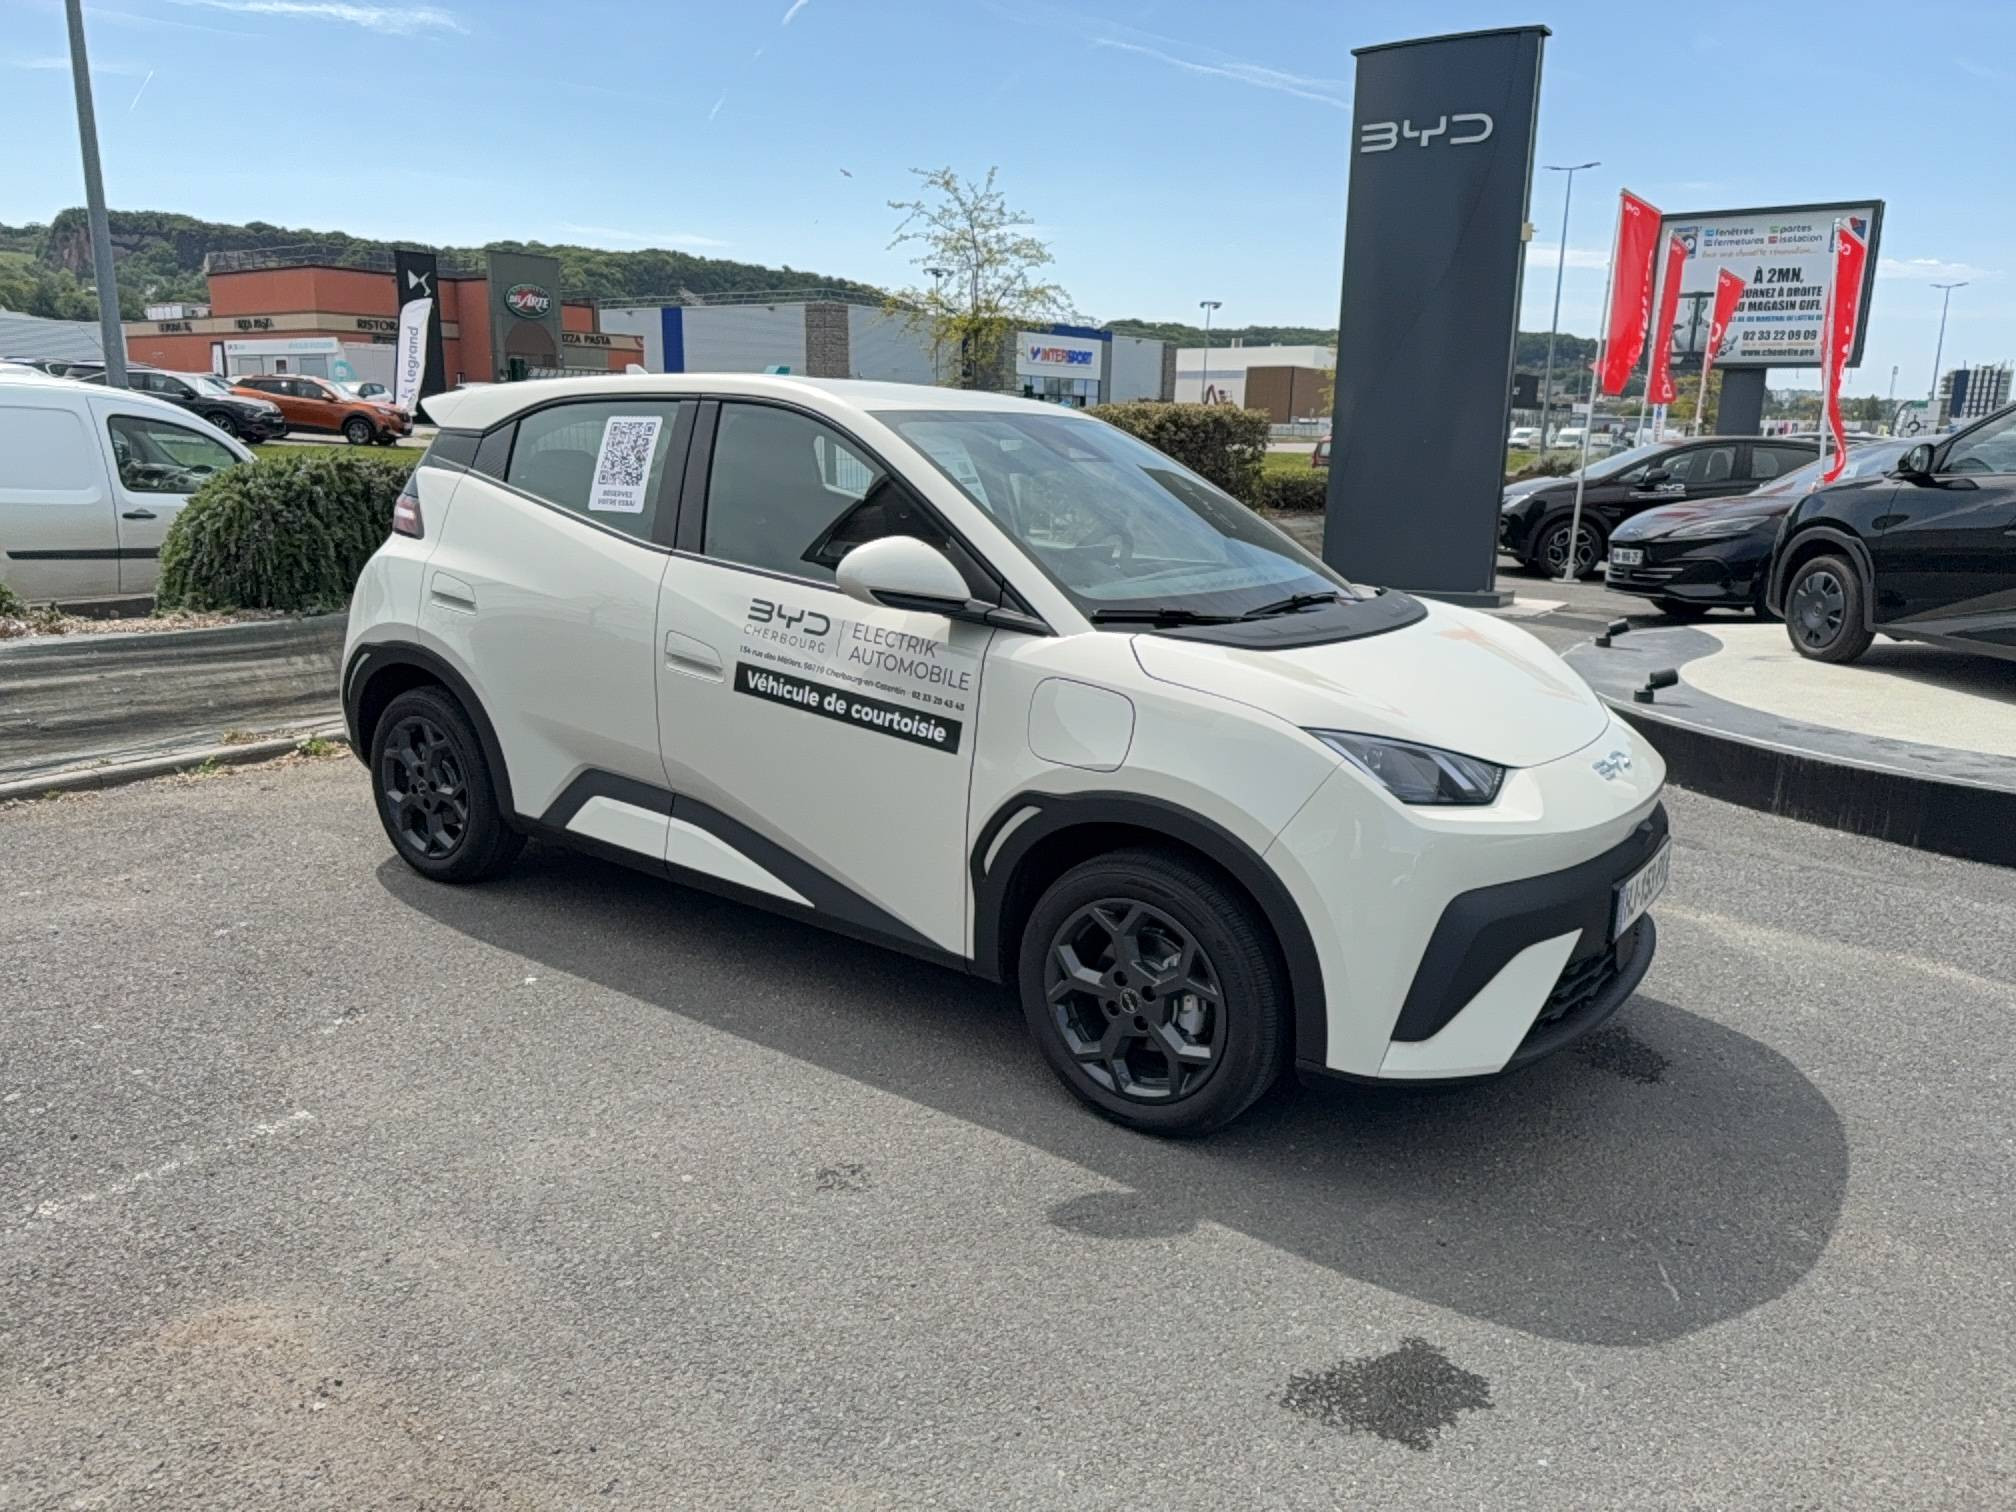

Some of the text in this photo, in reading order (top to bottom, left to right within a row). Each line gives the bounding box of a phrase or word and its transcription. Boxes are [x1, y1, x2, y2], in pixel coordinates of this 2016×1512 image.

[1361, 113, 1493, 152] BYD
[1753, 265, 1805, 284] À 2MN,
[1738, 288, 1776, 298] OURNEZ
[1786, 286, 1823, 297] DROITE
[1748, 301, 1797, 312] MAGASIN
[562, 333, 581, 344] IZZA
[1743, 330, 1756, 341] 02
[1758, 330, 1771, 340] 33
[1772, 330, 1786, 340] 22
[1041, 347, 1093, 365] INTERSPORT
[748, 598, 831, 636] BYD
[744, 624, 826, 654] CHERBOURG
[852, 622, 938, 658] ELECTRIK
[848, 646, 972, 691] AUTOMOBILE
[747, 669, 947, 742] Véhicule de courtoisie
